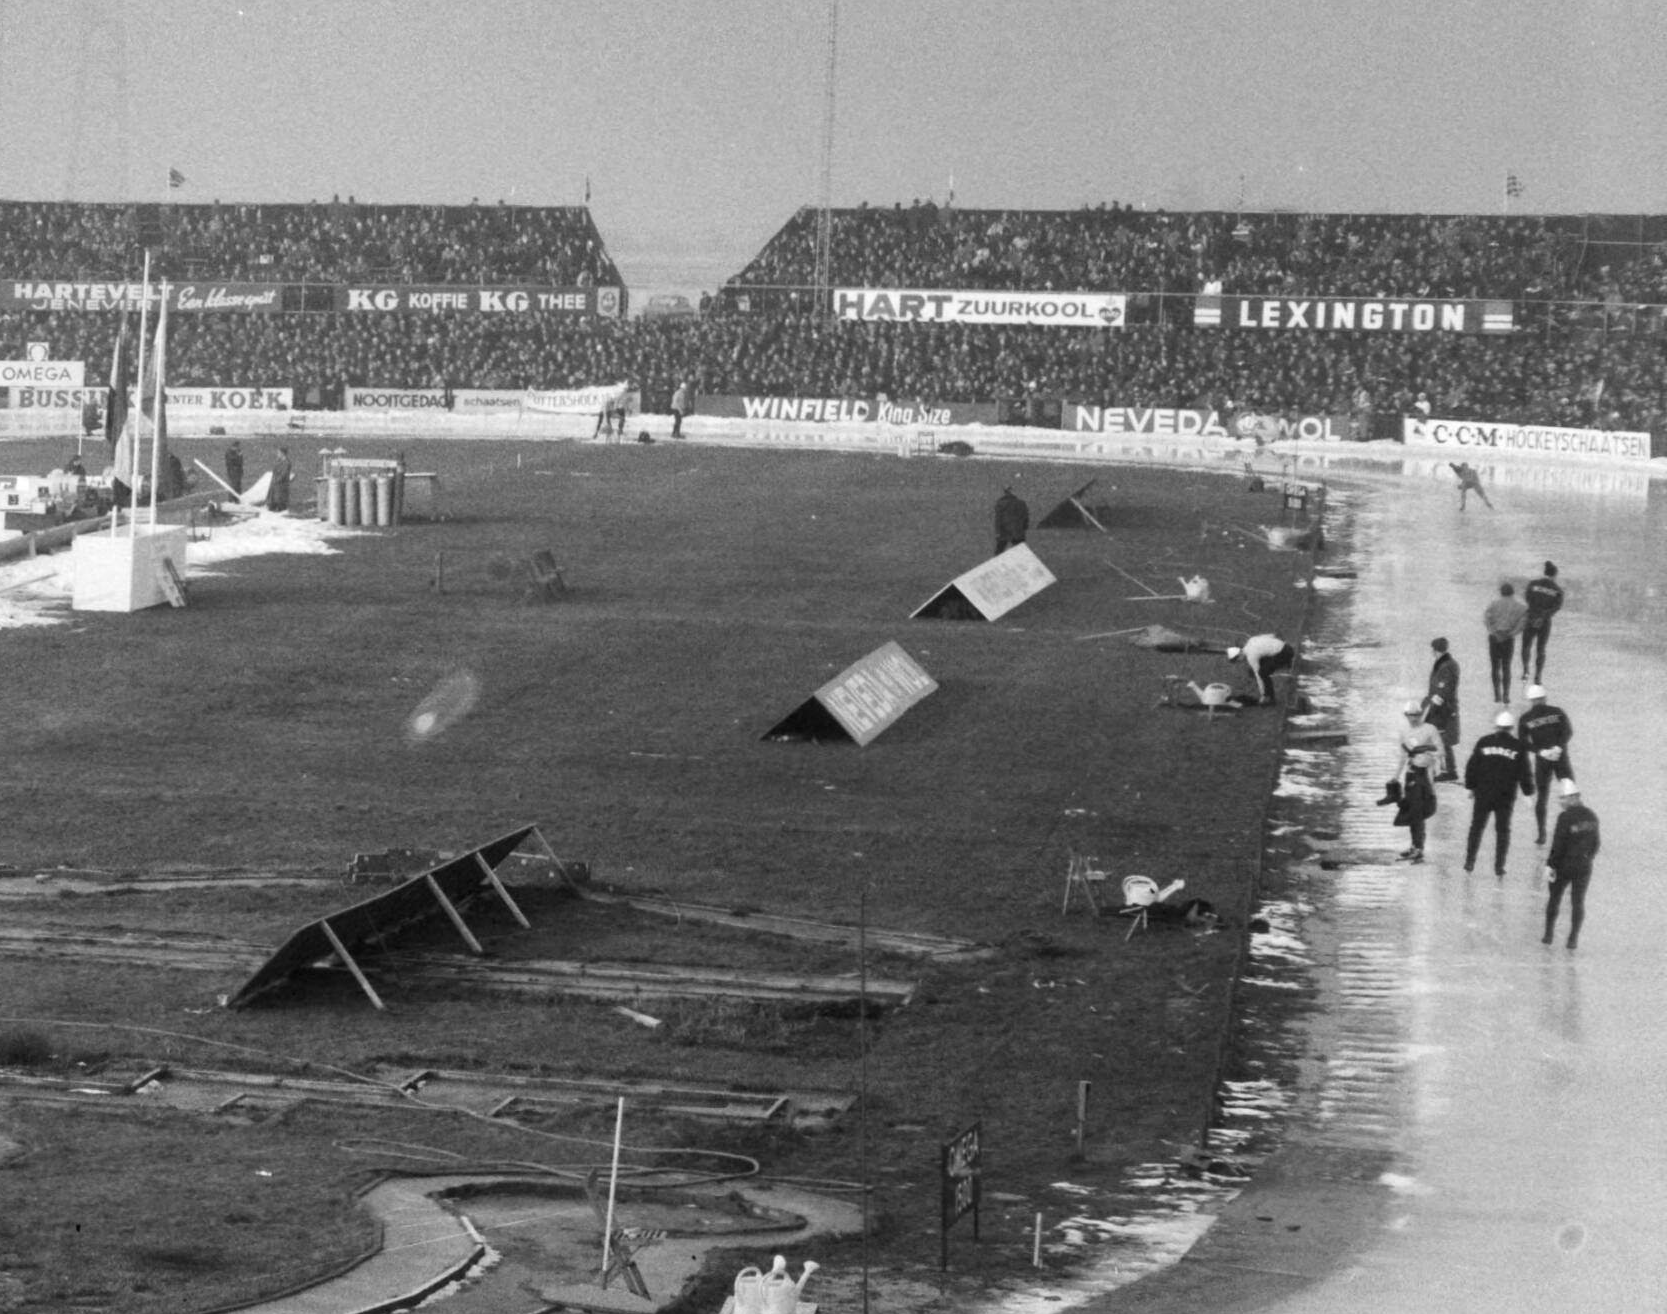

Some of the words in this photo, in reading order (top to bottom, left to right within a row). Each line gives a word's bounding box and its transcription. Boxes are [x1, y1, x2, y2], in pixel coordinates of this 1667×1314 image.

[14, 283, 174, 300] HARTEVELT
[347, 289, 399, 311] KG
[409, 292, 467, 309] KOFFIE
[479, 290, 530, 312] KG
[537, 293, 586, 309] THEE
[32, 299, 153, 311] JENEVER
[838, 293, 953, 318] HART
[957, 300, 1094, 319] ZUURKOOL
[1239, 300, 1465, 331] LEXINGTON
[2, 366, 72, 381] OMEGA
[210, 390, 283, 410] KOEK
[463, 396, 520, 408] schaatsen
[742, 397, 869, 421] WINFIELD
[877, 401, 912, 424] King
[918, 402, 951, 424] Size
[1076, 406, 1228, 436] NEVEDA
[1506, 429, 1647, 456] HOCKEYSCHAATSEN
